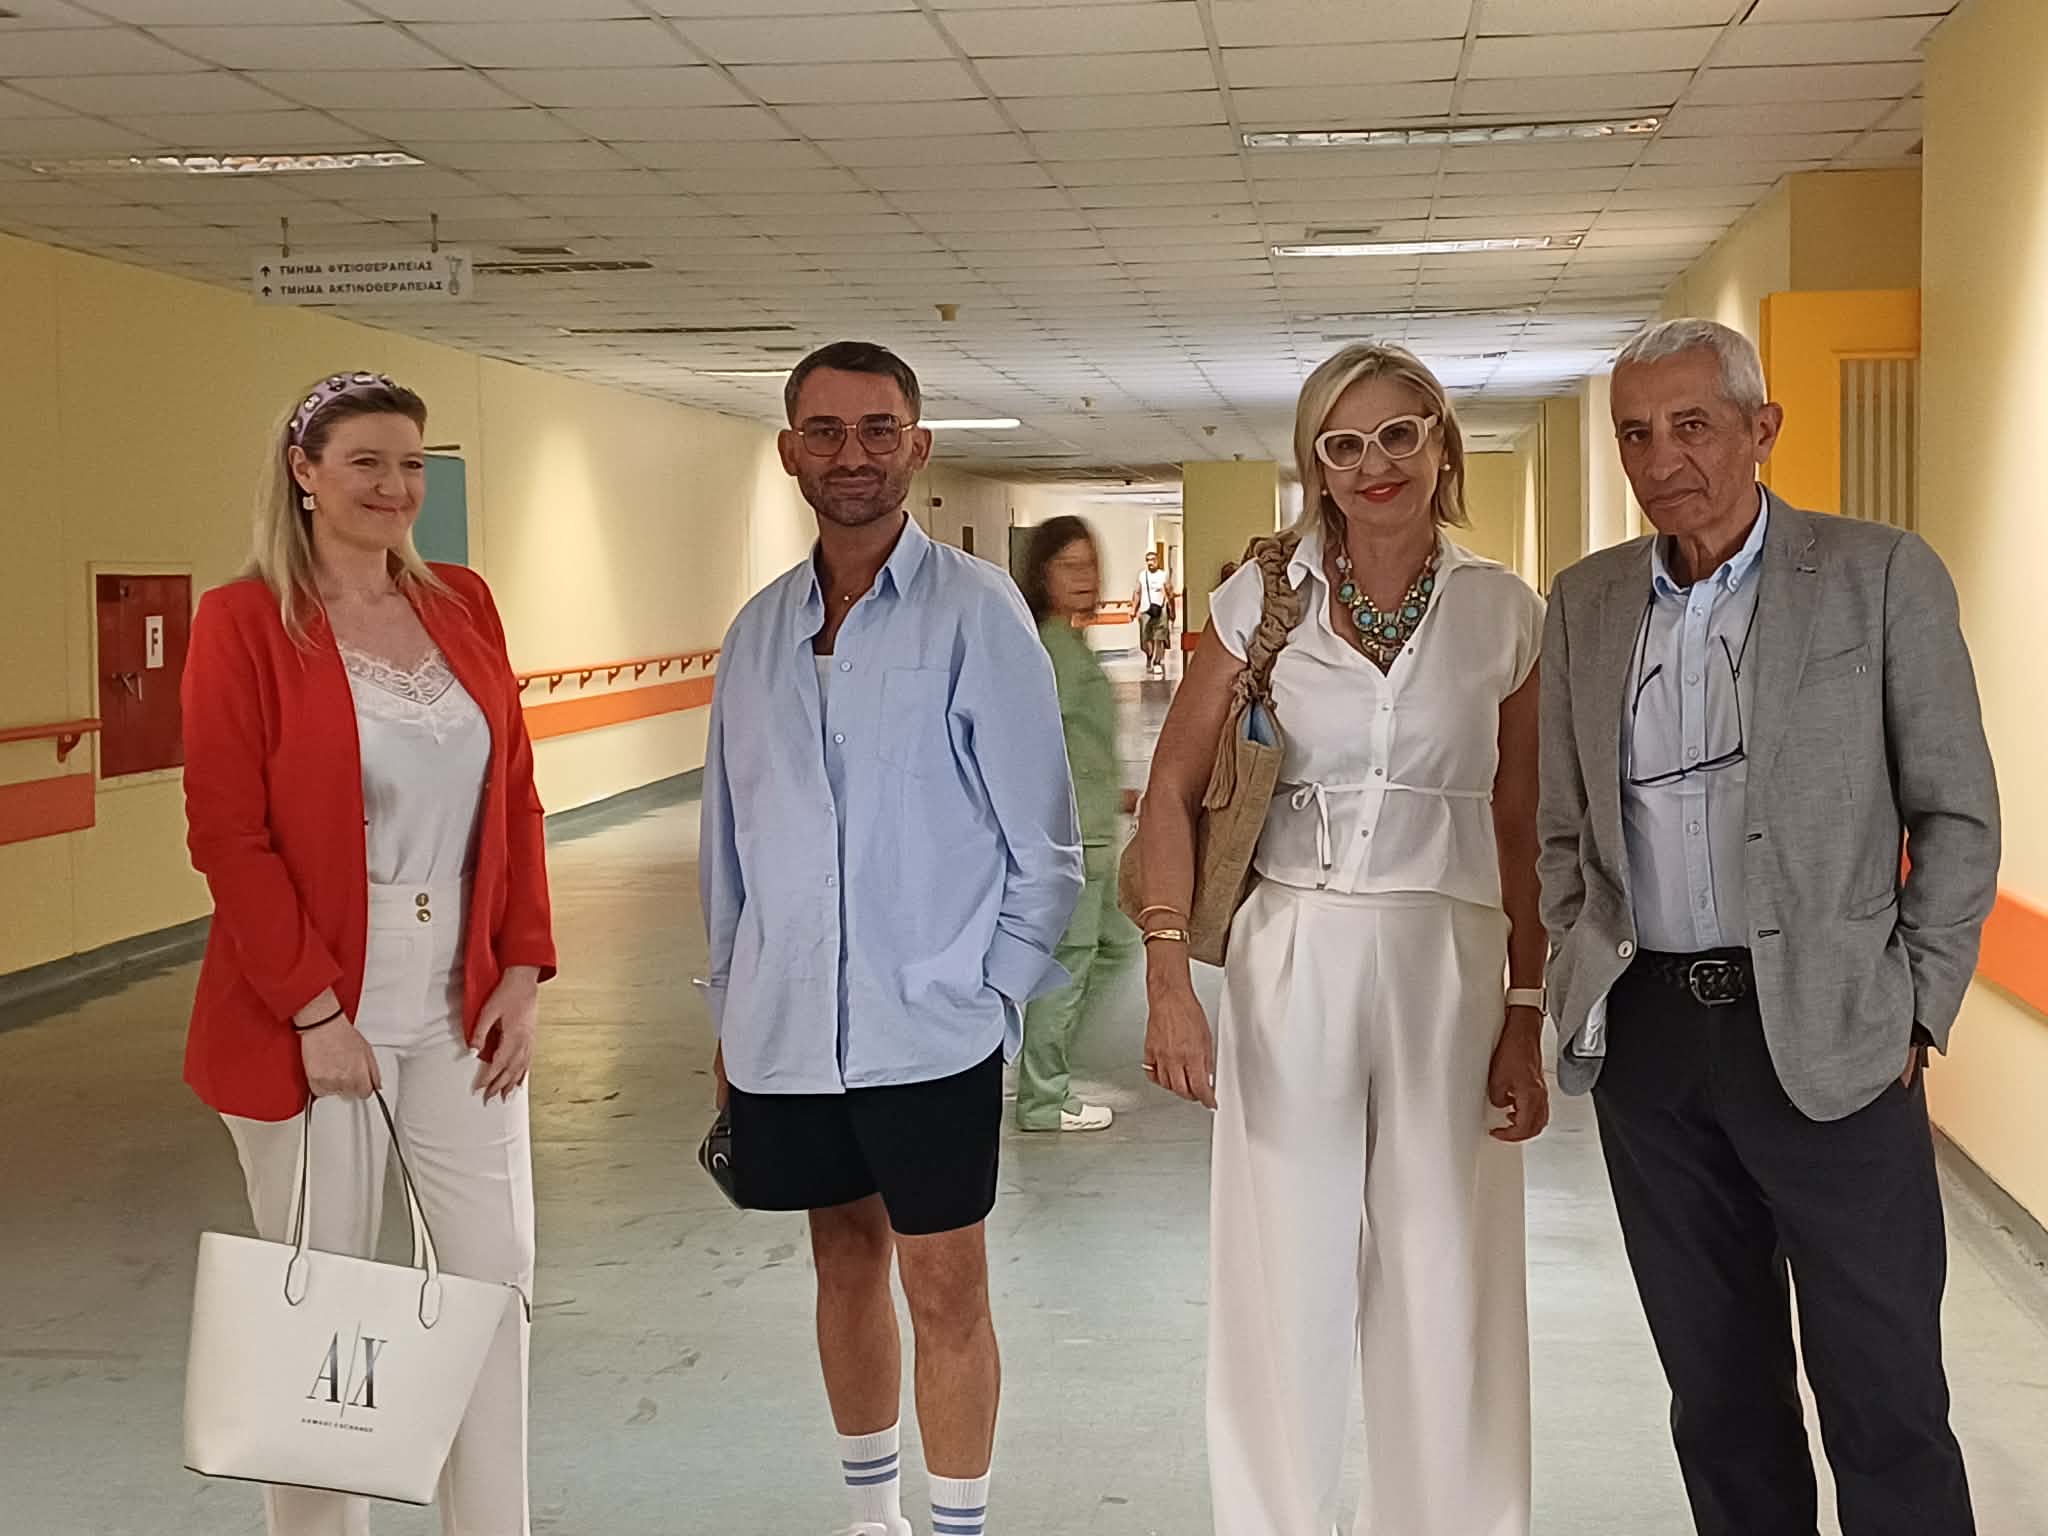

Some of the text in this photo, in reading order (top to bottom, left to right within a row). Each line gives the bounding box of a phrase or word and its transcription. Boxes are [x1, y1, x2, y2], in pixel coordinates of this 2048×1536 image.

[279, 264, 323, 275] ΤΜΗΜΑ
[279, 284, 323, 295] ΤΜΗΜΑ
[151, 626, 159, 657] F
